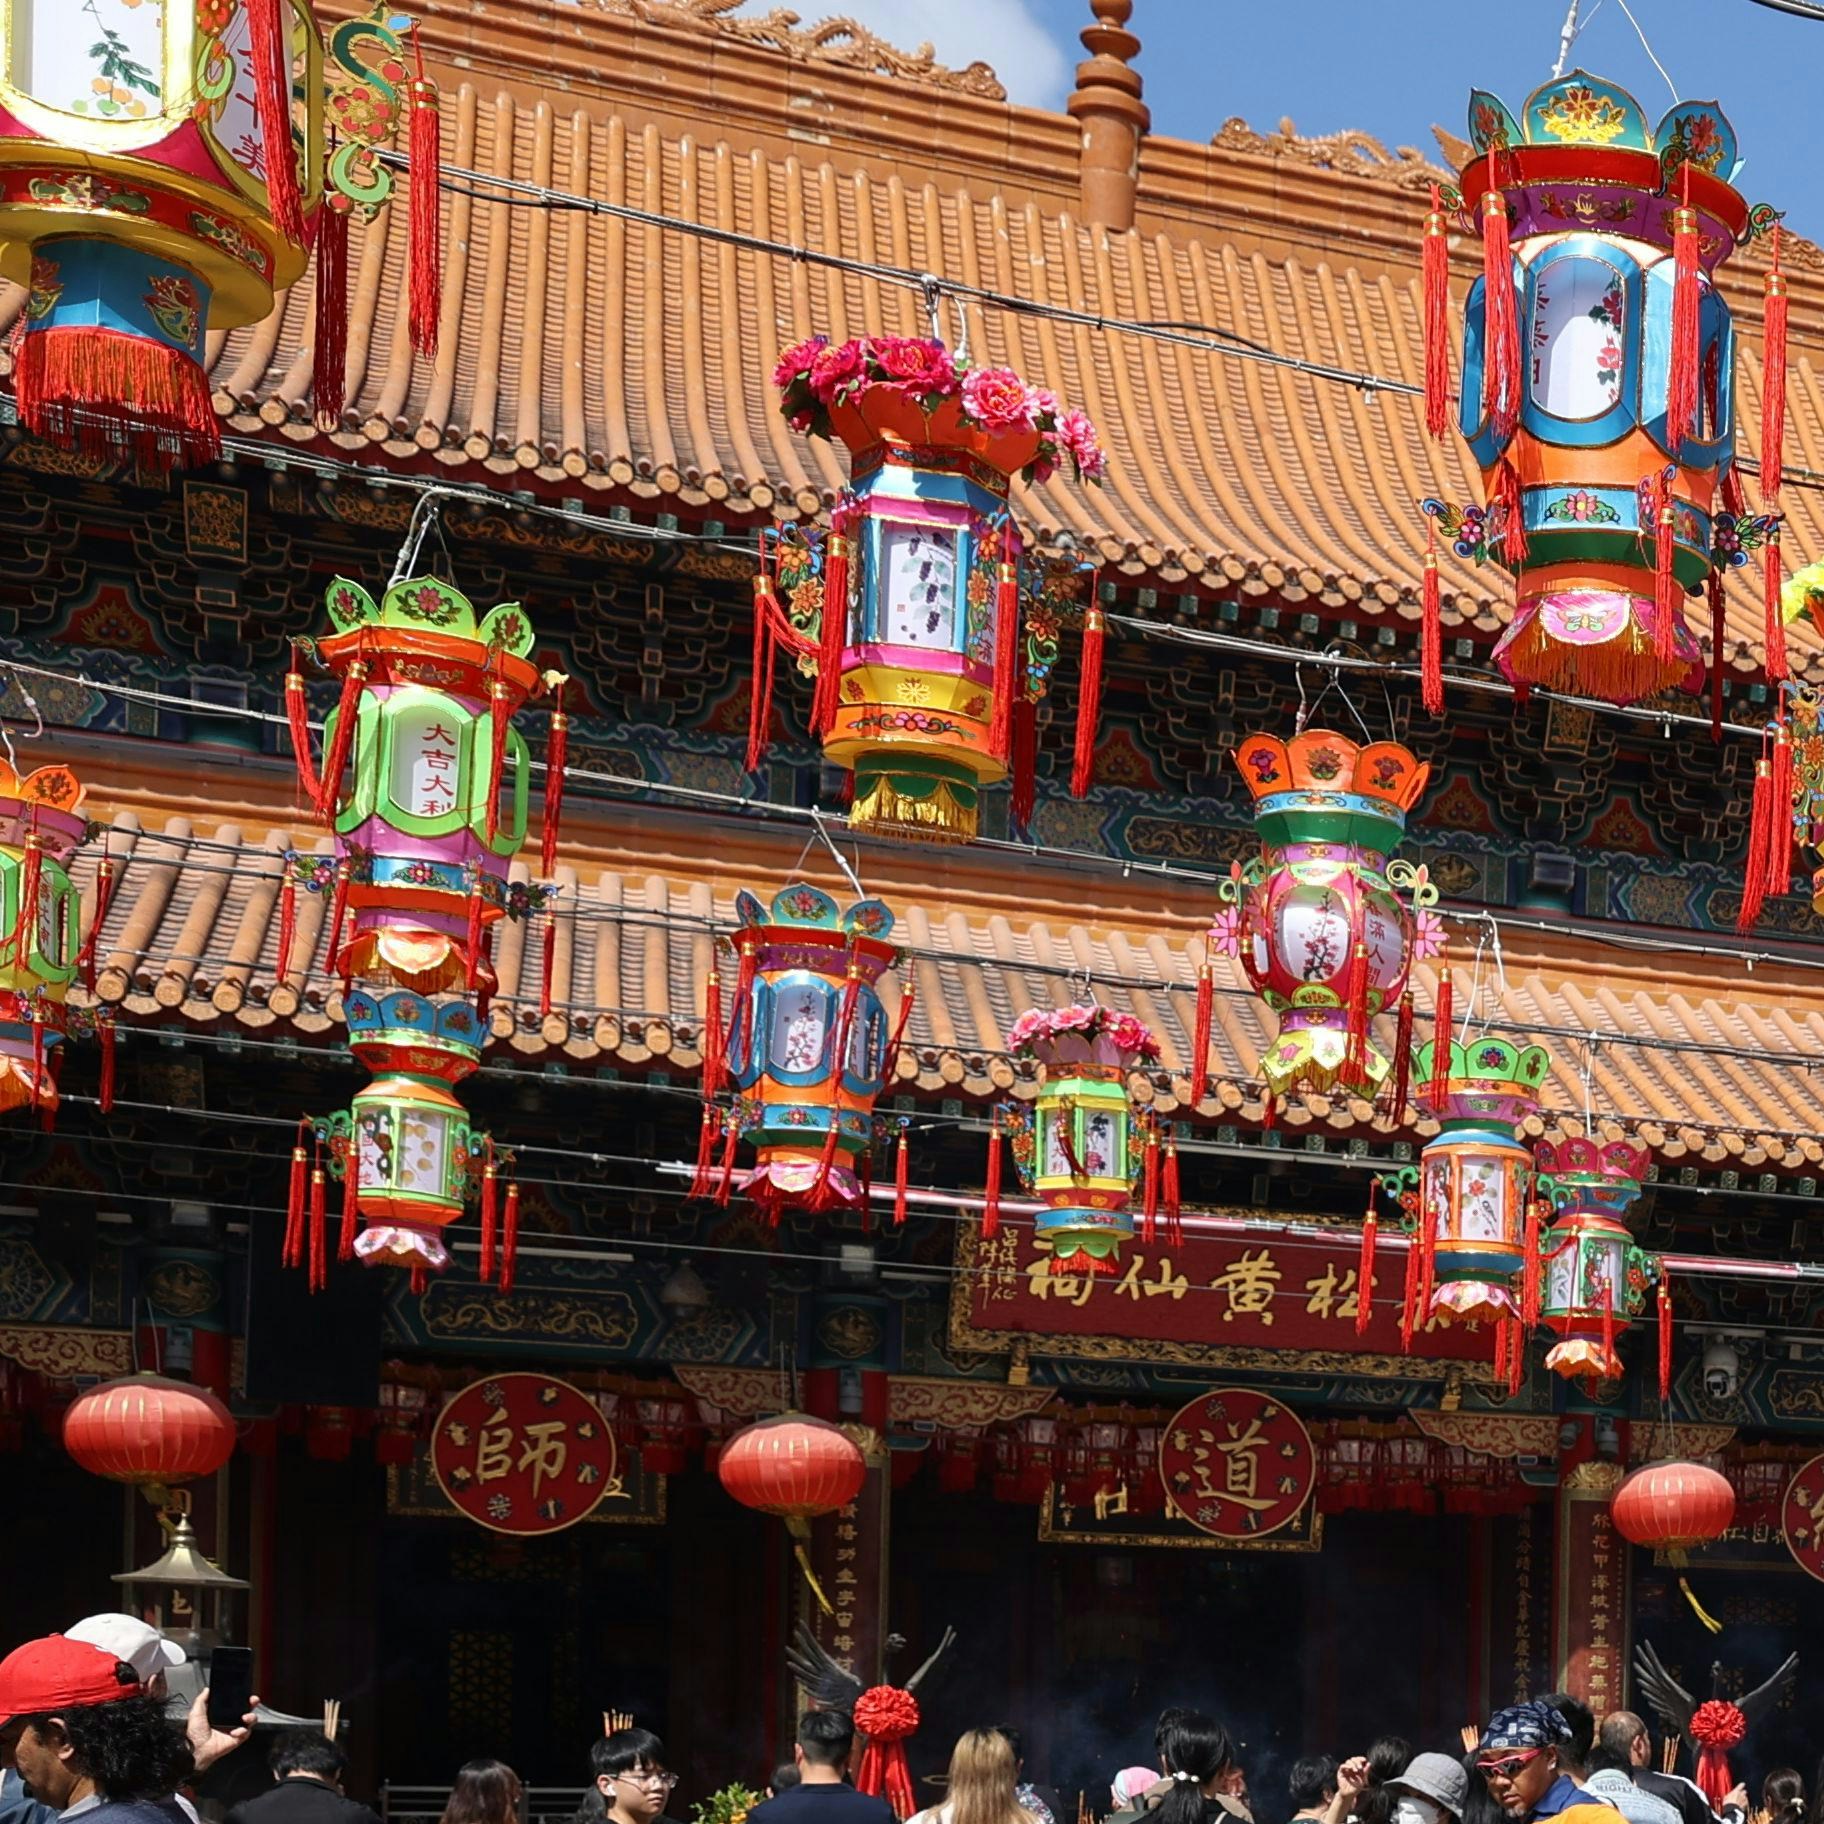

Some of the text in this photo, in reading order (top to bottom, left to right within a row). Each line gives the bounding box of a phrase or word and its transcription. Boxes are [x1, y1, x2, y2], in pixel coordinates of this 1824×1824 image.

[421, 723, 457, 815] 大吉大利
[477, 1406, 569, 1501] 師
[1193, 1421, 1280, 1511] 道
